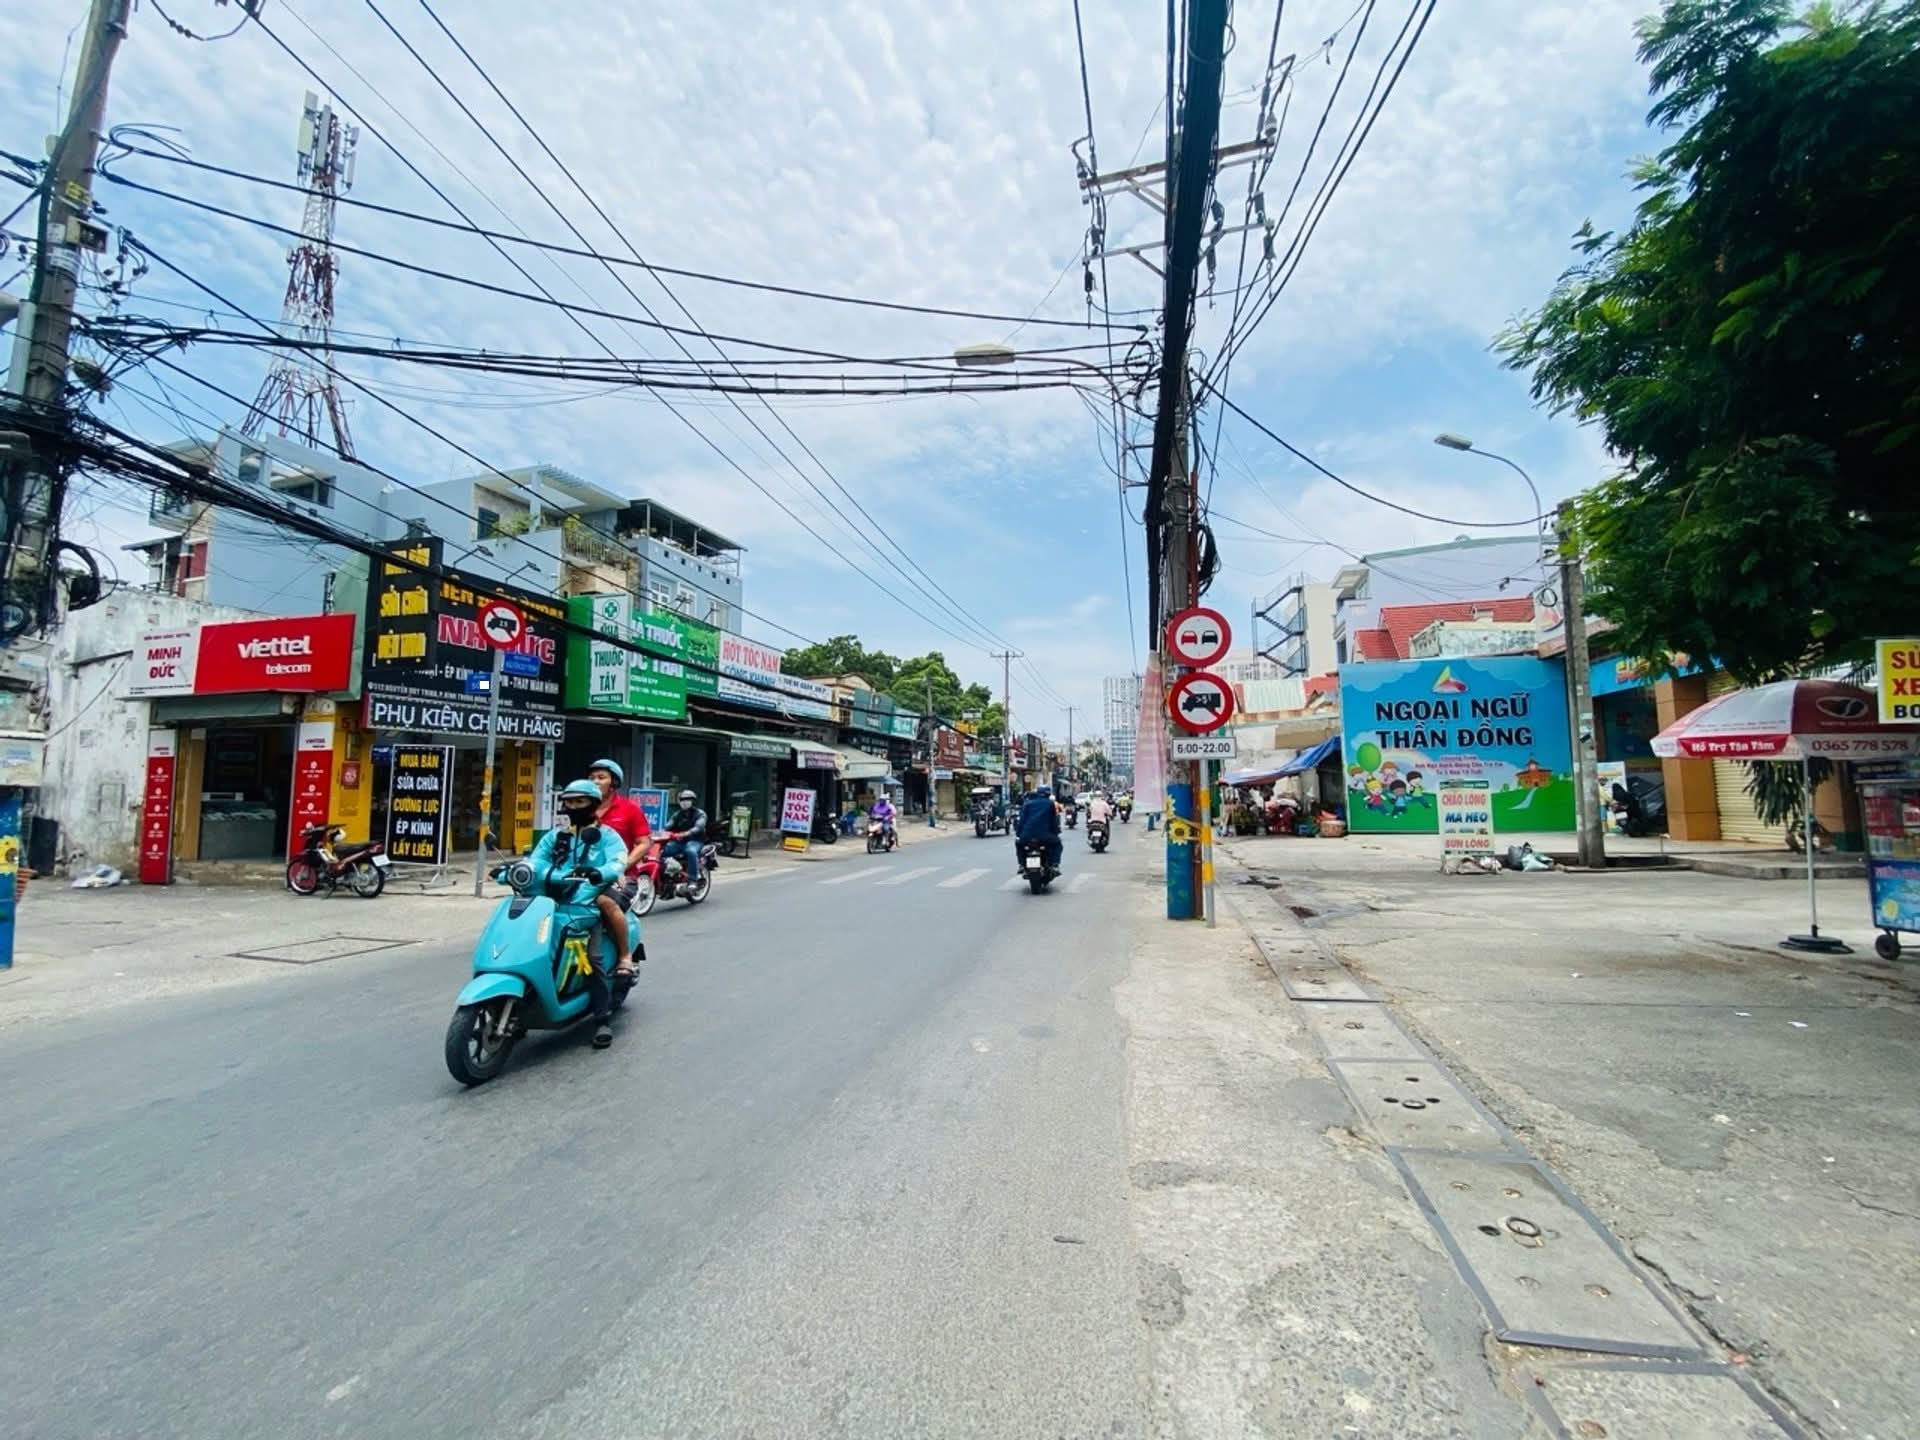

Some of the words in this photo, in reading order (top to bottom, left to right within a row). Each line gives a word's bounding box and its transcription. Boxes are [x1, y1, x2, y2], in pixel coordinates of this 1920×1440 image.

[147, 646, 182, 661] MINH
[237, 635, 313, 659] viettel
[722, 638, 741, 663] HỚT
[743, 641, 761, 668] TÓC
[761, 652, 779, 673] NAM
[594, 647, 624, 667] THUỐC
[149, 661, 176, 679] ĐỨC
[265, 662, 312, 675] telecom
[1375, 699, 1460, 725] NGOẠI
[1471, 691, 1531, 719] NGỮ
[373, 702, 415, 728] PHỤ
[421, 704, 464, 731] KIỆN
[468, 713, 520, 734] CHNH
[523, 715, 562, 738] HÃNG
[1375, 720, 1448, 750] THẦN
[1457, 717, 1533, 747] ĐỒNG
[1812, 739, 1849, 751] 0365
[1851, 739, 1879, 751] 778
[400, 754, 419, 767] MUA
[420, 752, 439, 768] BÁN
[397, 771, 414, 790] SỬA
[416, 774, 439, 791] CHỮA
[393, 797, 422, 812] CƯỜNG
[423, 798, 439, 815] LỰC
[784, 811, 809, 822] NAM
[395, 820, 408, 835] ÉP
[411, 818, 434, 835] KÍNH
